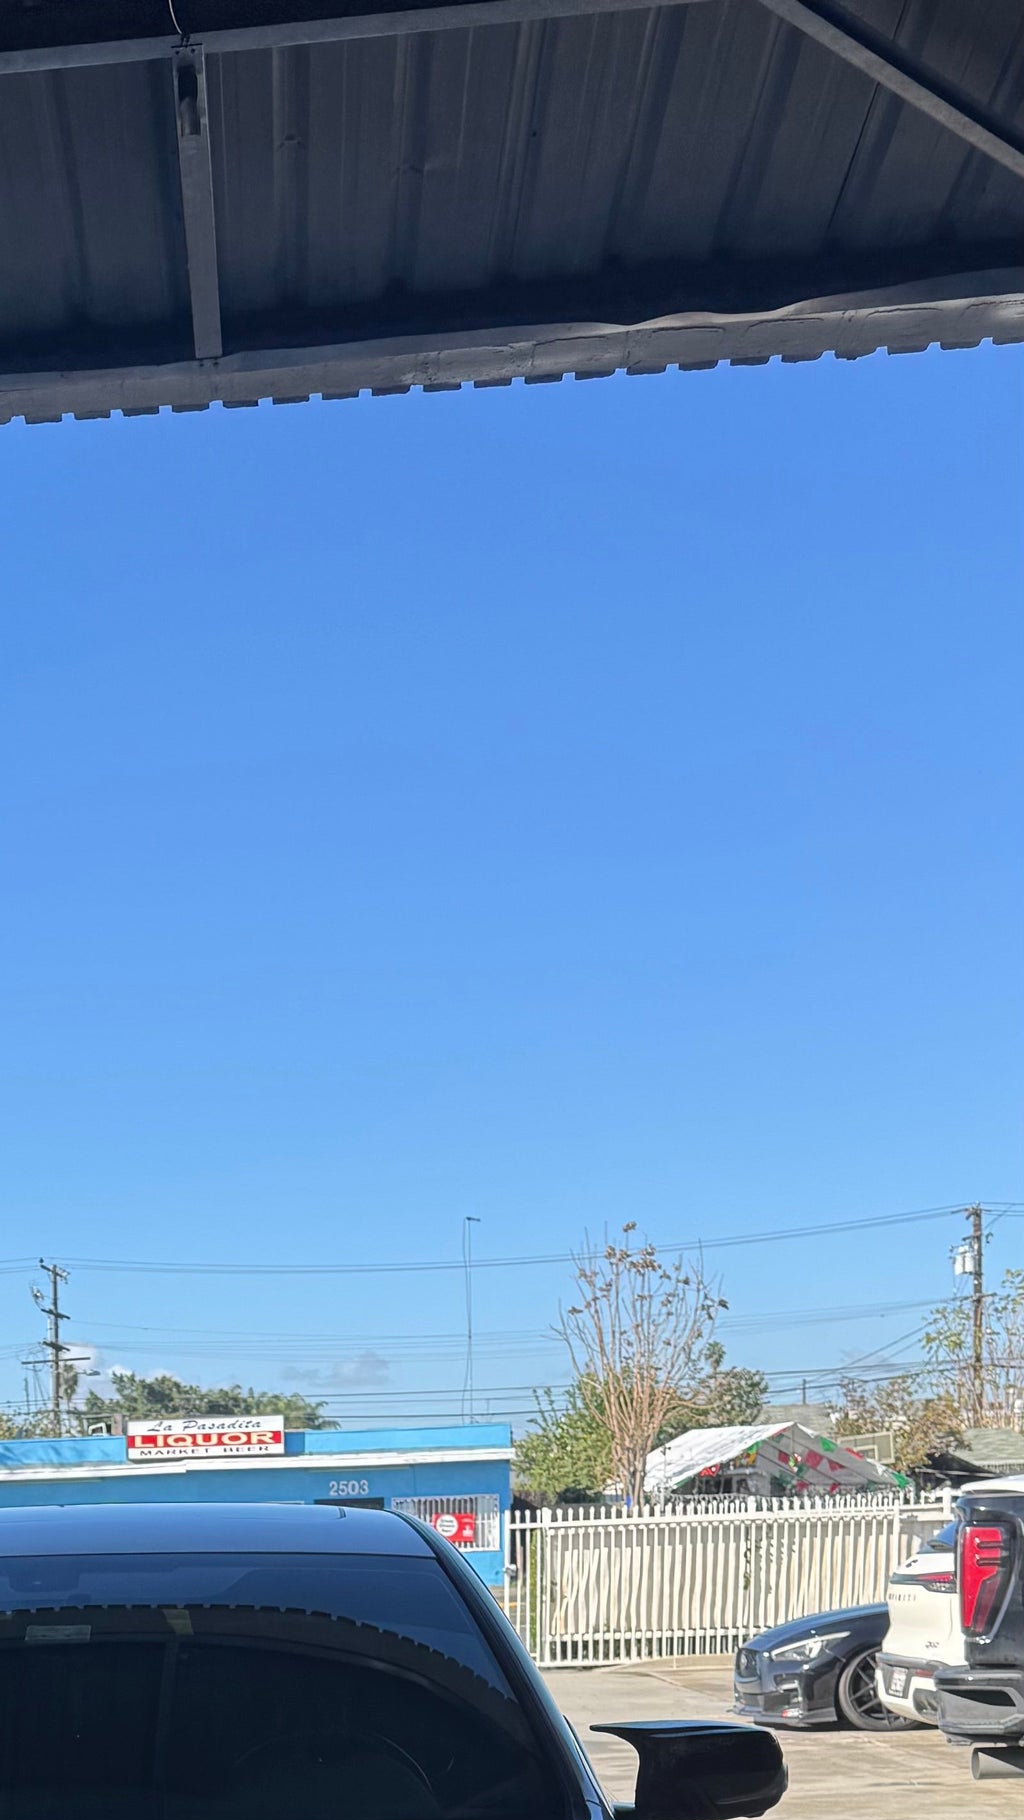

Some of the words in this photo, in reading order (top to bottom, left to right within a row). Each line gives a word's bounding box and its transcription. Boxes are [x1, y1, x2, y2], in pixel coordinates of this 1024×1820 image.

[147, 1421, 173, 1432] La
[182, 1419, 262, 1432] Pasadita
[134, 1431, 277, 1448] LIQUOR
[140, 1448, 210, 1456] MARKET
[329, 1480, 369, 1496] 2503
